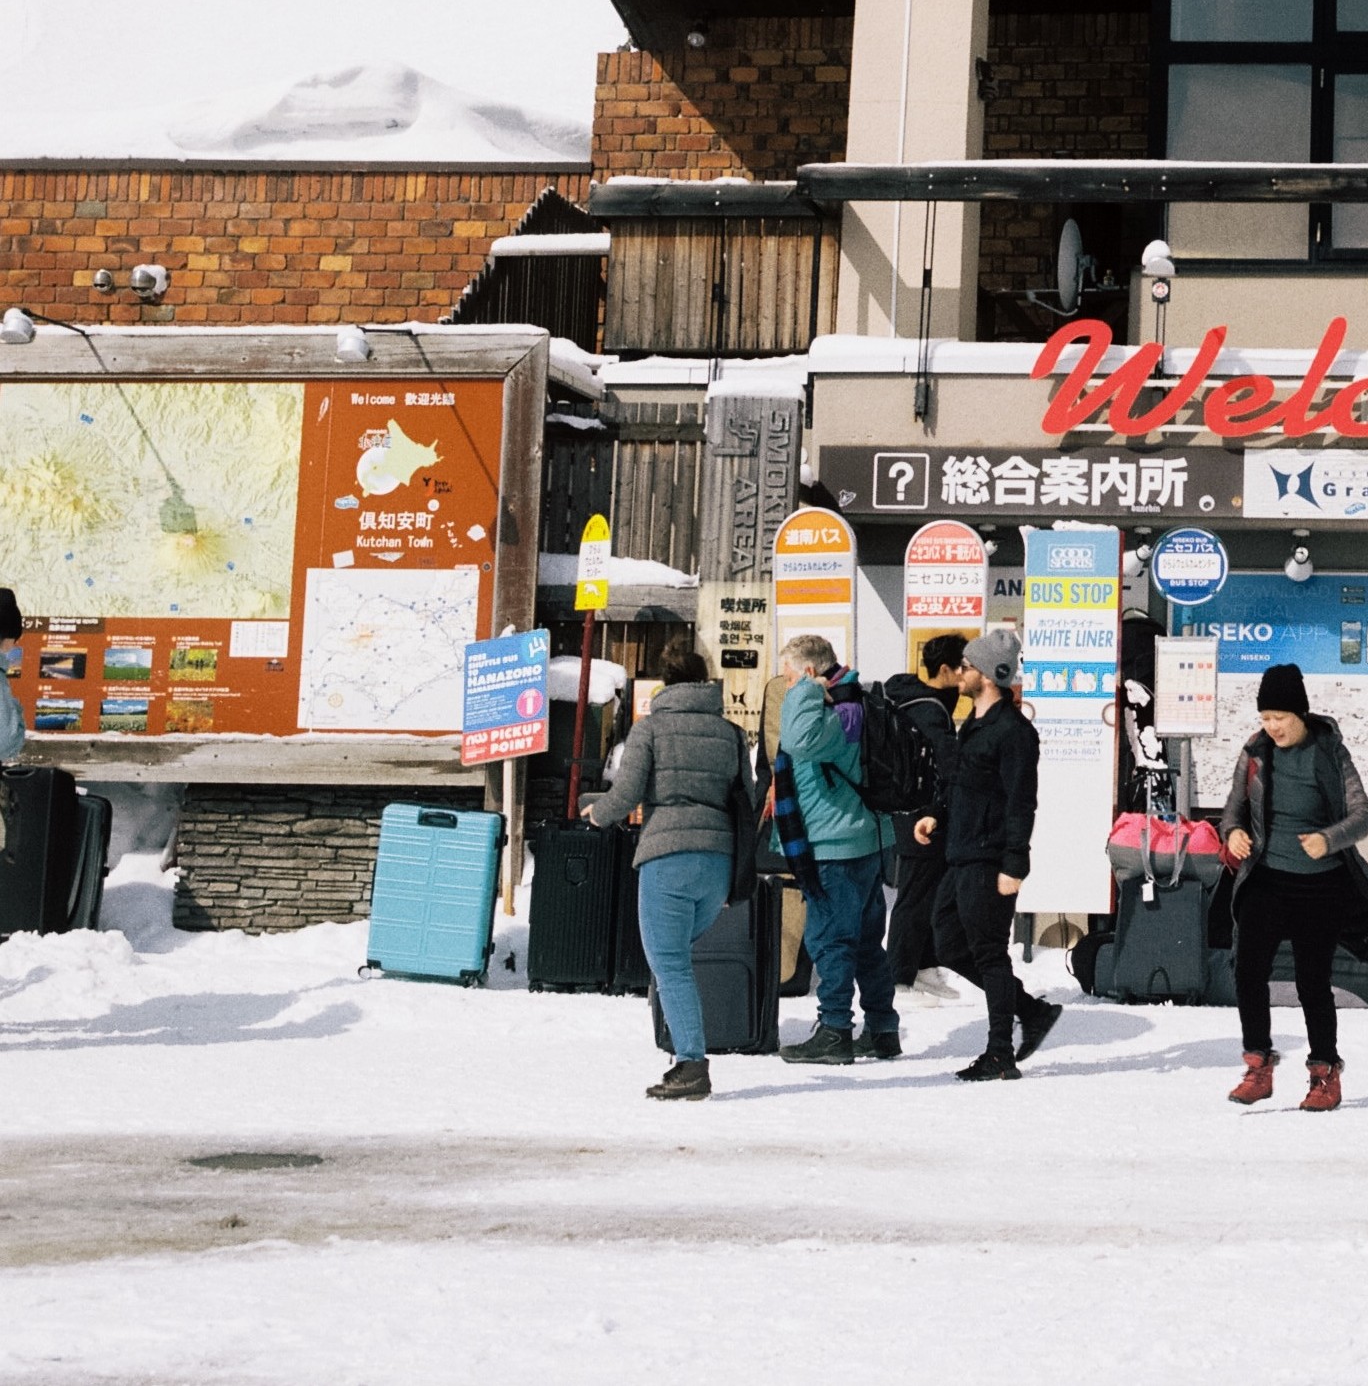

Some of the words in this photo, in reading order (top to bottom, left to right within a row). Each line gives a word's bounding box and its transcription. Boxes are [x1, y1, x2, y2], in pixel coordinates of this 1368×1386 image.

[351, 393, 395, 405] Welcome
[941, 455, 1188, 507] 総合案内所
[731, 478, 758, 575] AREA
[356, 536, 401, 548] Kutchan
[408, 536, 434, 548] Town
[785, 528, 841, 545] 道南バス
[1051, 548, 1092, 559] GOOD
[1165, 543, 1214, 552] ニセコバス
[908, 573, 983, 584] ニセコひらふ
[1170, 579, 1186, 587] BUS
[1188, 579, 1209, 587] STOP
[1030, 582, 1064, 603] BUS
[1070, 583, 1113, 604] STOP
[720, 597, 767, 613] 喫煙所
[911, 602, 976, 614] 中央バス
[1028, 629, 1071, 647] WHITE
[1075, 630, 1114, 647] LINER
[1193, 622, 1273, 642] ISEKO
[1280, 624, 1330, 641] APP
[743, 652, 755, 660] 2F
[467, 664, 543, 687] HANAZONO
[468, 668, 479, 677] TO
[490, 722, 541, 742] PICKUP
[490, 736, 534, 755] POINT
